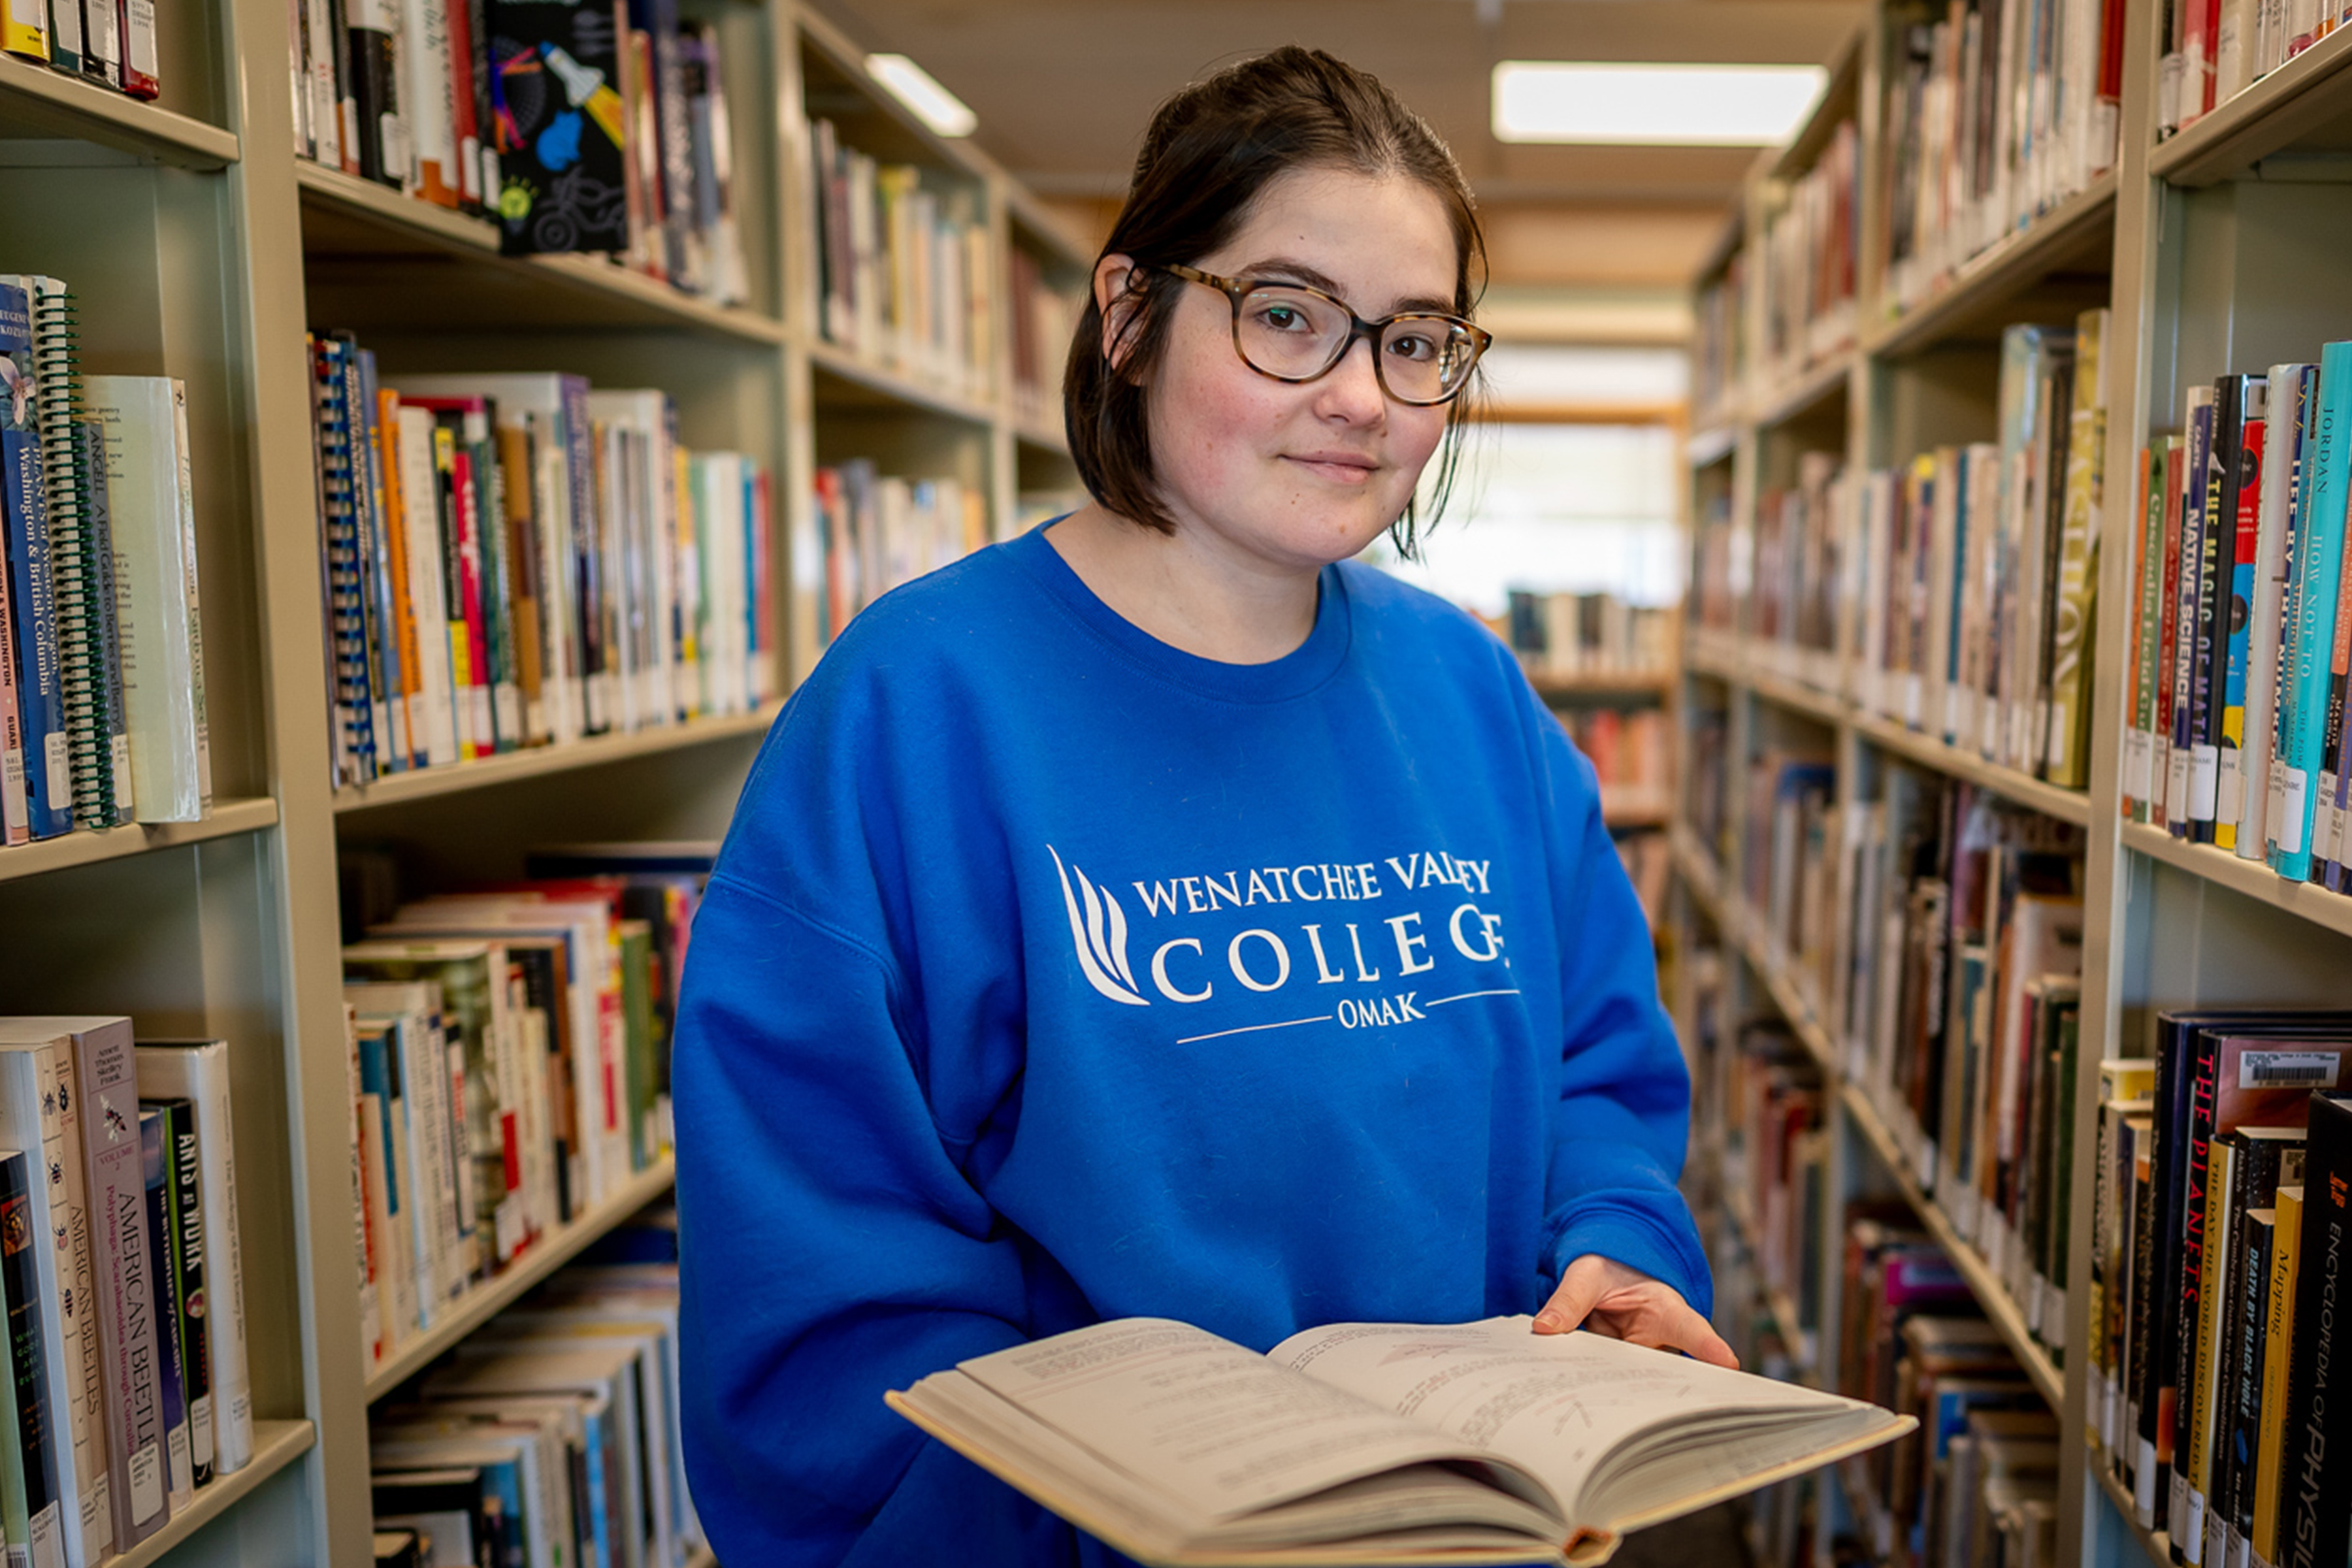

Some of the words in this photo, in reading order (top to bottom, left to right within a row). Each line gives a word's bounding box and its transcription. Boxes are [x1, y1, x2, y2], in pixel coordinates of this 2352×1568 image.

[90, 431, 105, 494] ANGELL
[2316, 406, 2334, 495] JORDAN
[19, 446, 35, 541] Washington
[95, 504, 106, 518] A
[2206, 478, 2221, 525] THE
[2288, 459, 2301, 515] LIFE
[27, 544, 39, 558] &
[97, 520, 109, 551] Field
[2181, 508, 2200, 595] NATIVE
[2285, 529, 2296, 563] BY
[2308, 535, 2323, 585] HOW
[29, 563, 44, 617] British
[100, 553, 112, 594] Guide
[2198, 538, 2217, 622] MAGIC
[104, 595, 112, 612] to
[2280, 581, 2290, 629] THE
[2303, 593, 2318, 640] NOT
[35, 621, 50, 696] Columbia
[105, 613, 117, 658] Berries
[2176, 604, 2195, 710] SCIENCE
[2195, 635, 2211, 665] OF
[109, 659, 120, 685] and
[2300, 647, 2313, 678] TO
[1132, 862, 1382, 918] WENATCHEE
[1384, 851, 1492, 894] VALEY
[1151, 903, 1510, 1004] COLLEGE
[1338, 992, 1426, 1029] OMAK
[2194, 1054, 2213, 1123] THE
[99, 1146, 135, 1166] VOLUME
[178, 1133, 198, 1186] ANTS
[2209, 1160, 2220, 1195] THE
[184, 1206, 203, 1273] WORK
[2183, 1139, 2208, 1304] PLANETS
[2207, 1201, 2217, 1234] DAY
[119, 1192, 147, 1343] AMERICAN
[2204, 1243, 2215, 1276] THE
[2247, 1246, 2259, 1298] DEATH
[71, 1205, 93, 1316] AMERICAN
[82, 1318, 101, 1416] BEETLES
[105, 1184, 119, 1254] Polyphaga:
[119, 1347, 133, 1394] through
[2199, 1282, 2212, 1348] WORLD
[2246, 1302, 2256, 1324] BY
[2270, 1249, 2289, 1336] Mapping
[2315, 1220, 2343, 1389] ENCYCLOPEDIA
[2242, 1324, 2255, 1376] BLACK
[131, 1345, 158, 1452] BEETLE
[2190, 1352, 2208, 1465] DISCOVERED
[2240, 1376, 2251, 1418] HOLE
[2312, 1395, 2325, 1429] OF
